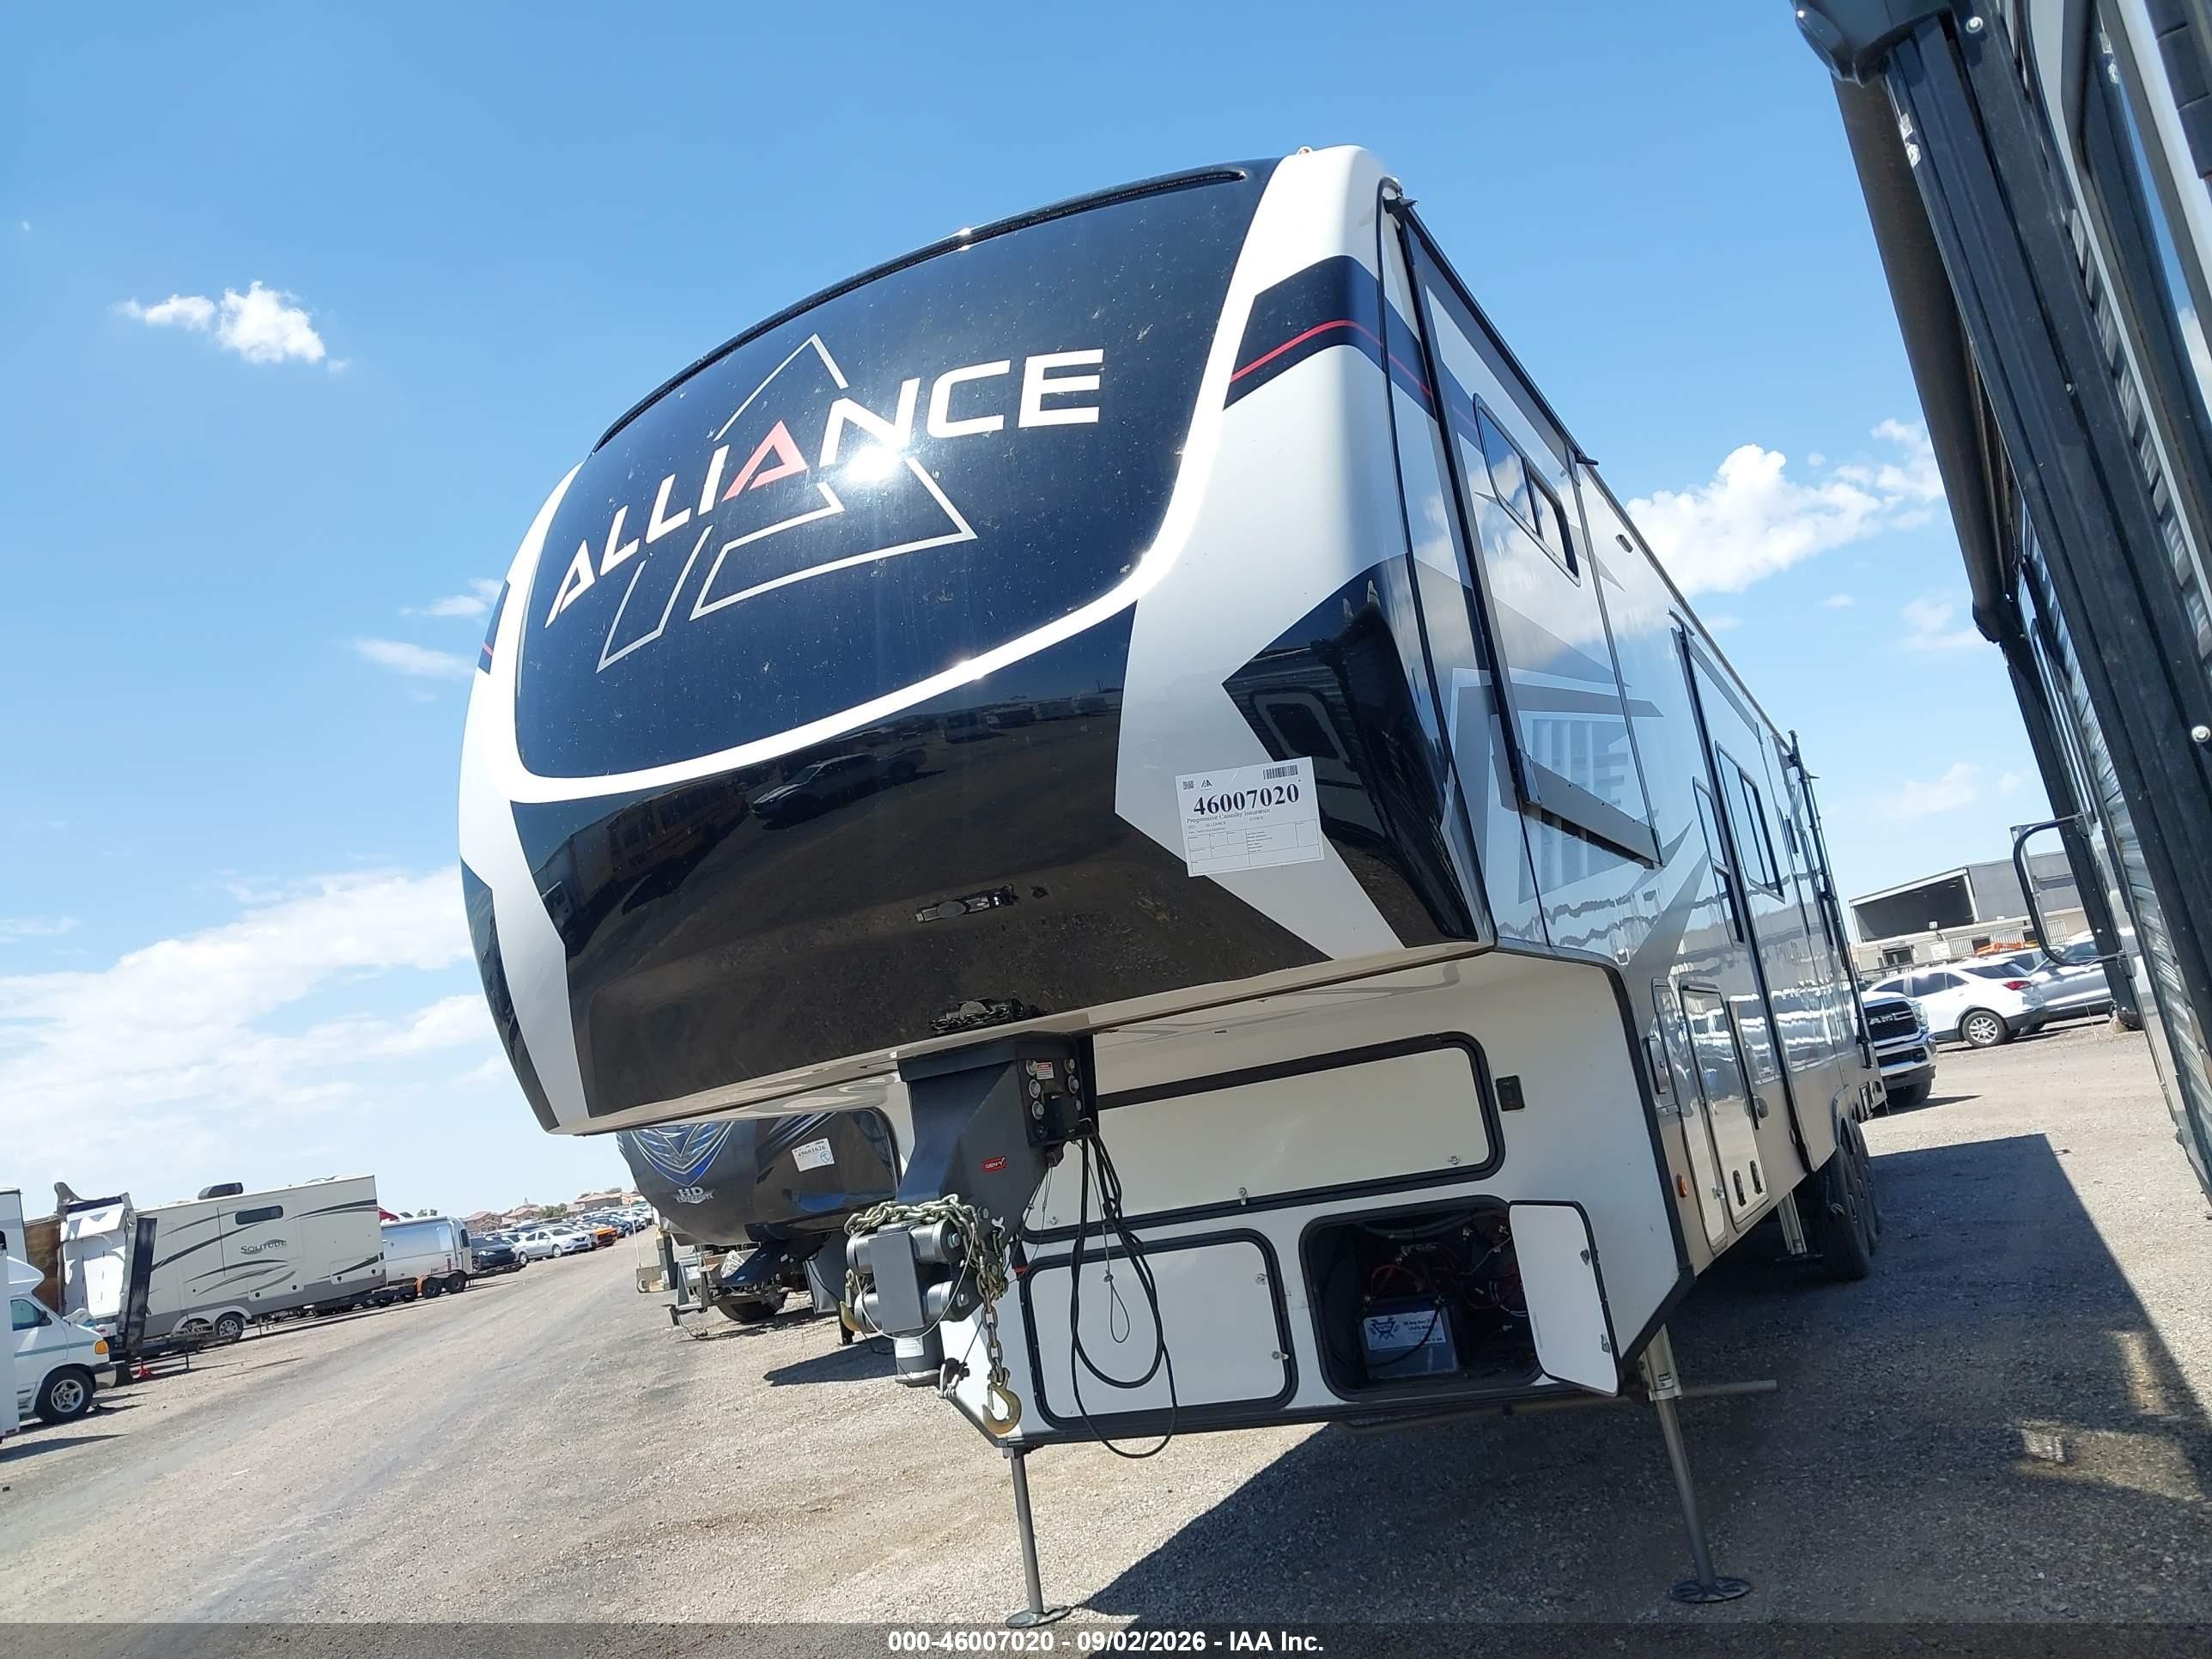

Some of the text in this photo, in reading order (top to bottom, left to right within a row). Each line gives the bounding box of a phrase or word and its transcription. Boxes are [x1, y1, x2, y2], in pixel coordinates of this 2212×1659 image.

[545, 349, 1104, 629] ALLIANCE
[1193, 783, 1299, 815] 46007020
[1186, 815, 1218, 824] Progressive
[678, 1187, 704, 1197] HD
